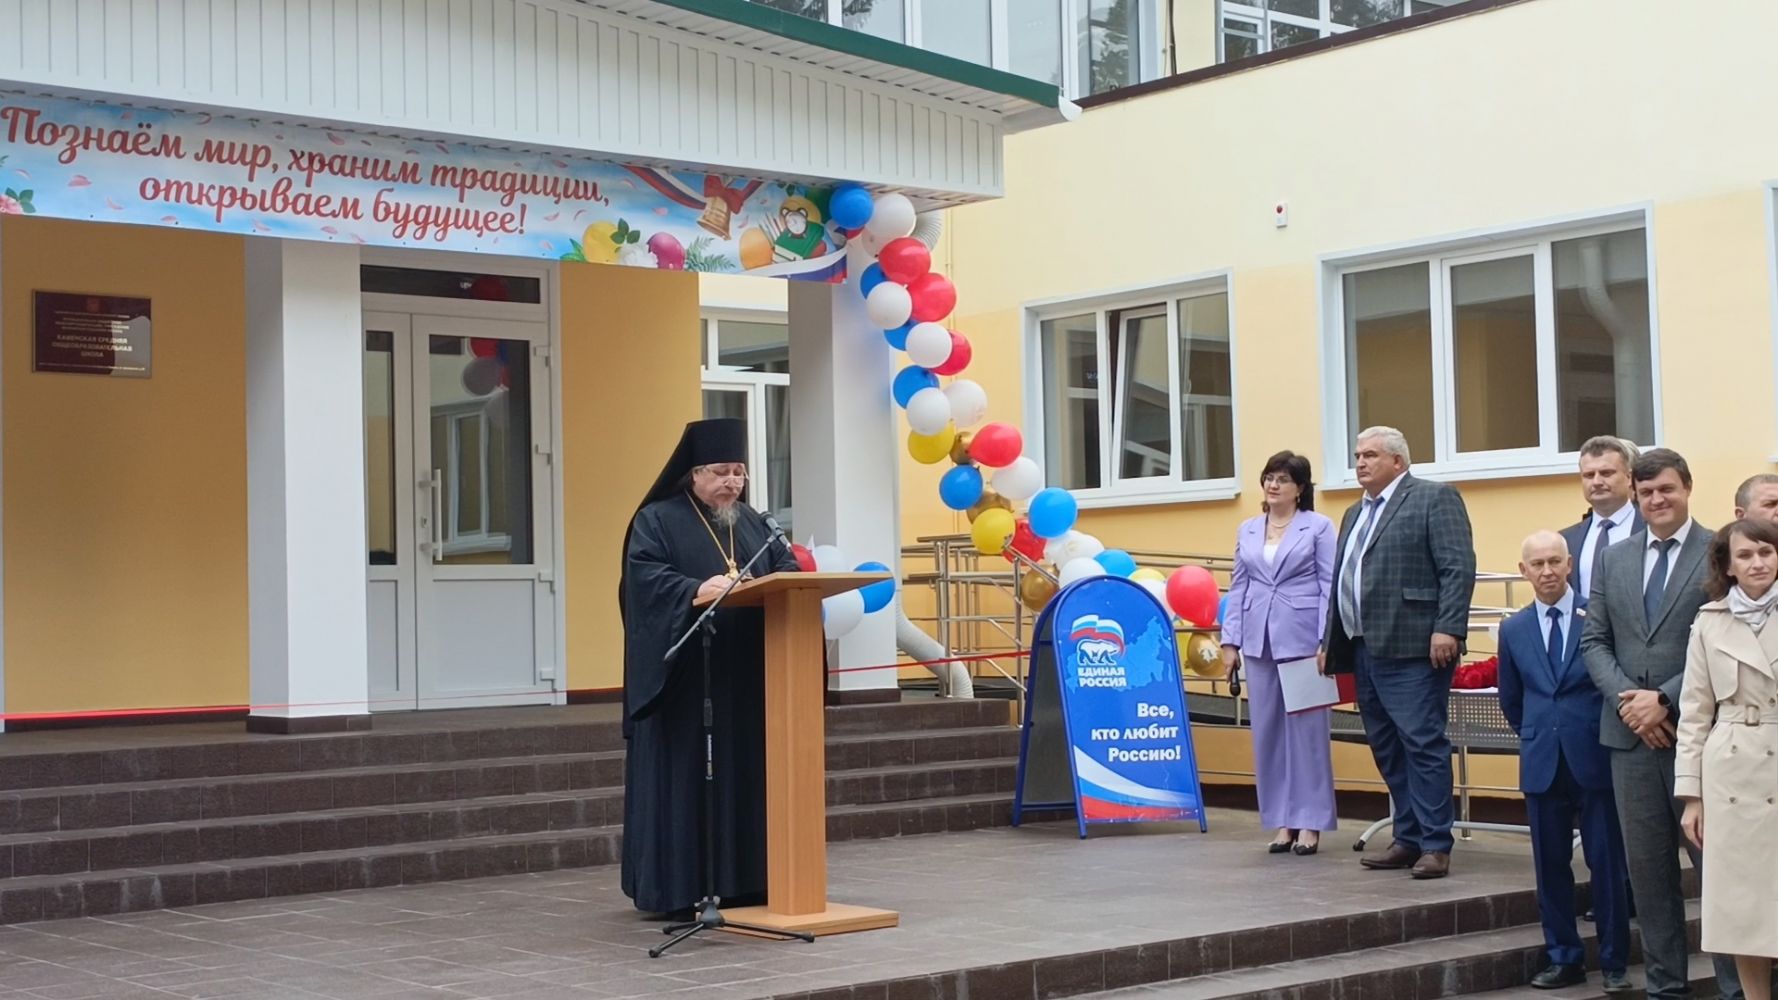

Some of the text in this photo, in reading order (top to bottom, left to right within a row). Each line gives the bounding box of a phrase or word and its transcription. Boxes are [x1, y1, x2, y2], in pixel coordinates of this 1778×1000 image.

[0, 106, 610, 206] Познаём мир, храним традиции,
[139, 176, 527, 241] открываем будущее!
[1078, 667, 1126, 678] ЕДИНАЯ
[1079, 677, 1127, 688] РОССИЯ
[1137, 703, 1174, 719] Все,
[1091, 724, 1178, 740] кто любит
[1108, 745, 1182, 762] Россию!
